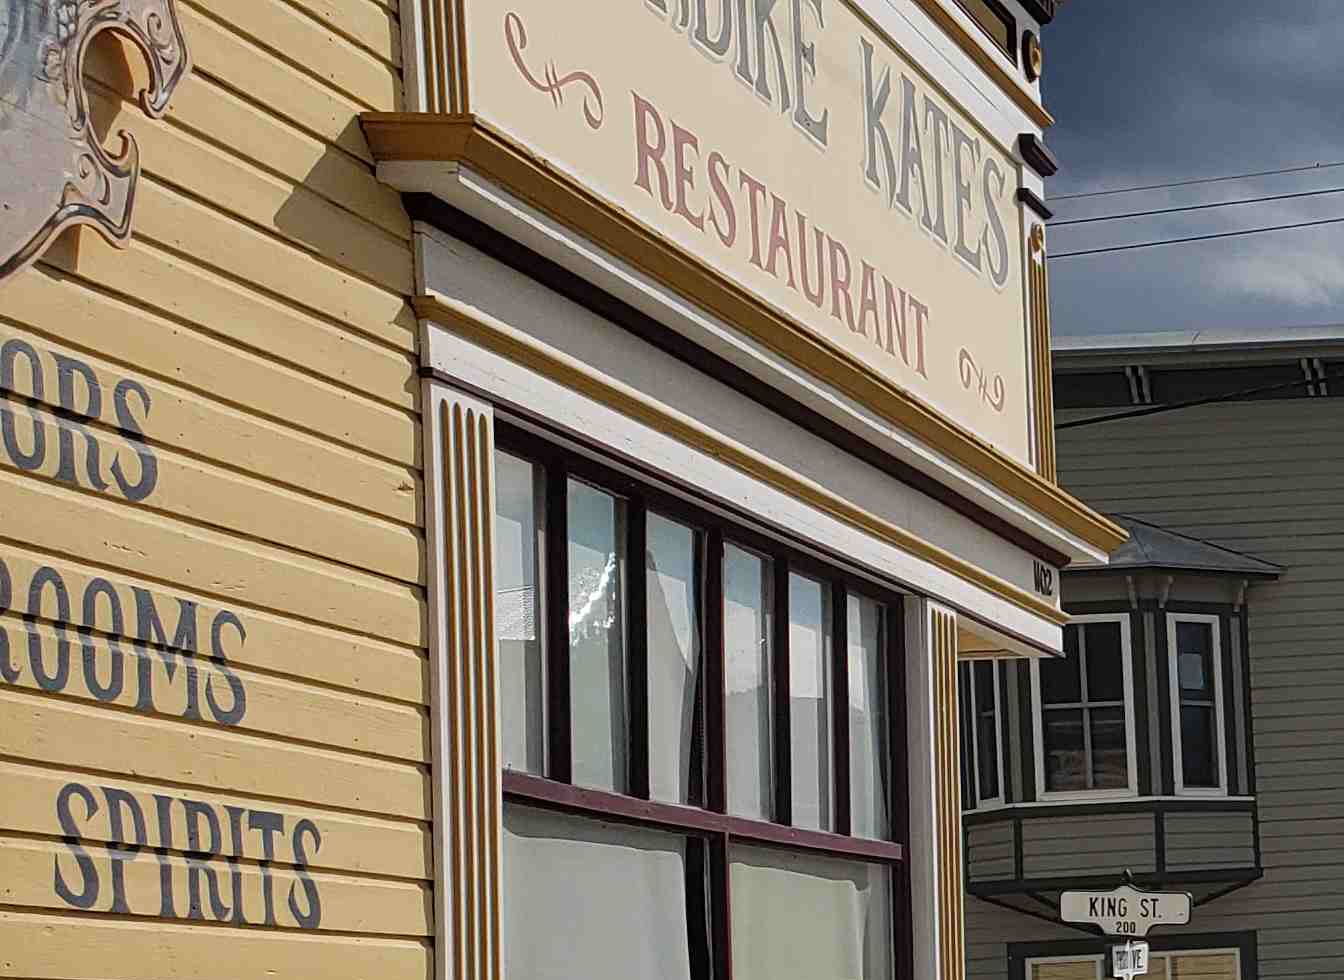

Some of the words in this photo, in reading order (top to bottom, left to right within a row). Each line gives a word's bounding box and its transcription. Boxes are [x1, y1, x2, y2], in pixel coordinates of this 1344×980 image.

[631, 90, 931, 381] RESTAURANT
[860, 36, 1010, 290] KATE'S
[0, 338, 158, 501] ORS
[54, 782, 322, 930] SPIRITS
[1088, 897, 1128, 918] KING
[1140, 898, 1163, 919] ST.
[1115, 921, 1137, 934] 200
